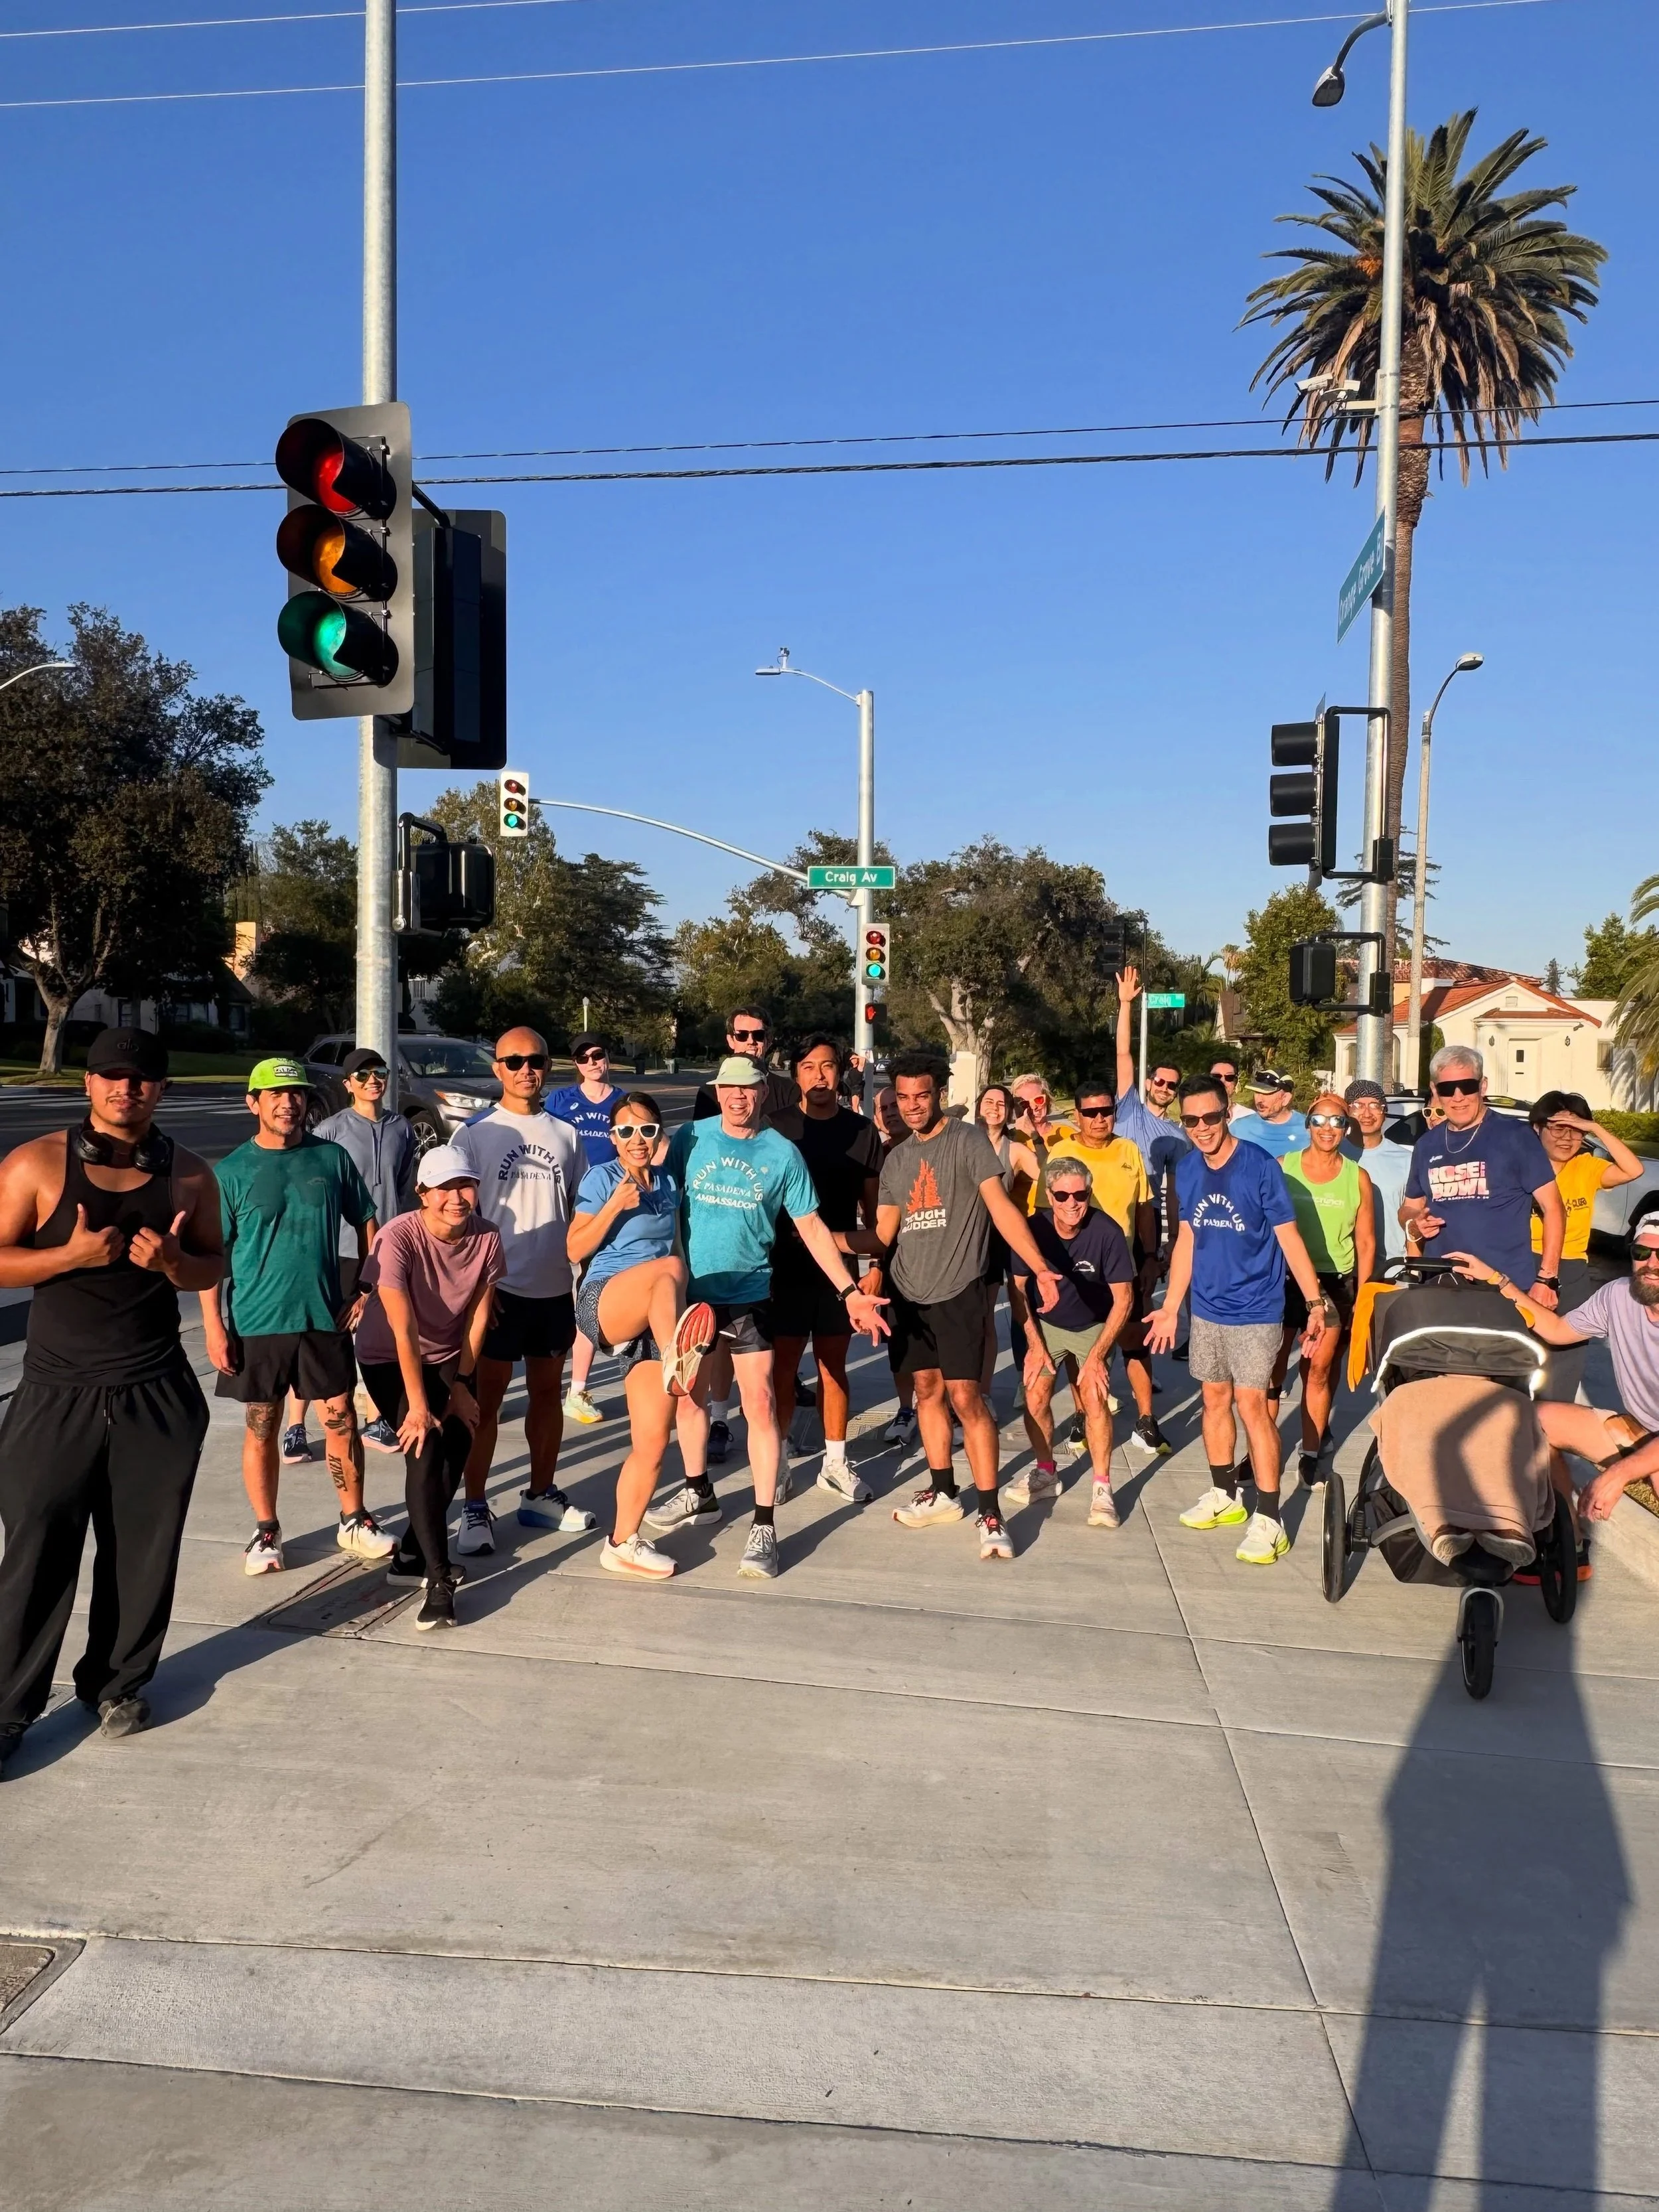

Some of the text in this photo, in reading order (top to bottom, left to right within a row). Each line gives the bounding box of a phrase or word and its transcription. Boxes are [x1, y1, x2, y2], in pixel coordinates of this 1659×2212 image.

[825, 871, 877, 885] Craig Av
[498, 1149, 519, 1181] RUN
[518, 1144, 555, 1164] WITH
[510, 1170, 551, 1180] PASADENA
[693, 1157, 764, 1201] RUN WITH US
[703, 1183, 751, 1197] PASADENA
[695, 1193, 757, 1210] AMBASSADOR
[904, 1209, 946, 1225] TUGH
[1193, 1199, 1209, 1228] RUN
[1232, 1213, 1246, 1232] US
